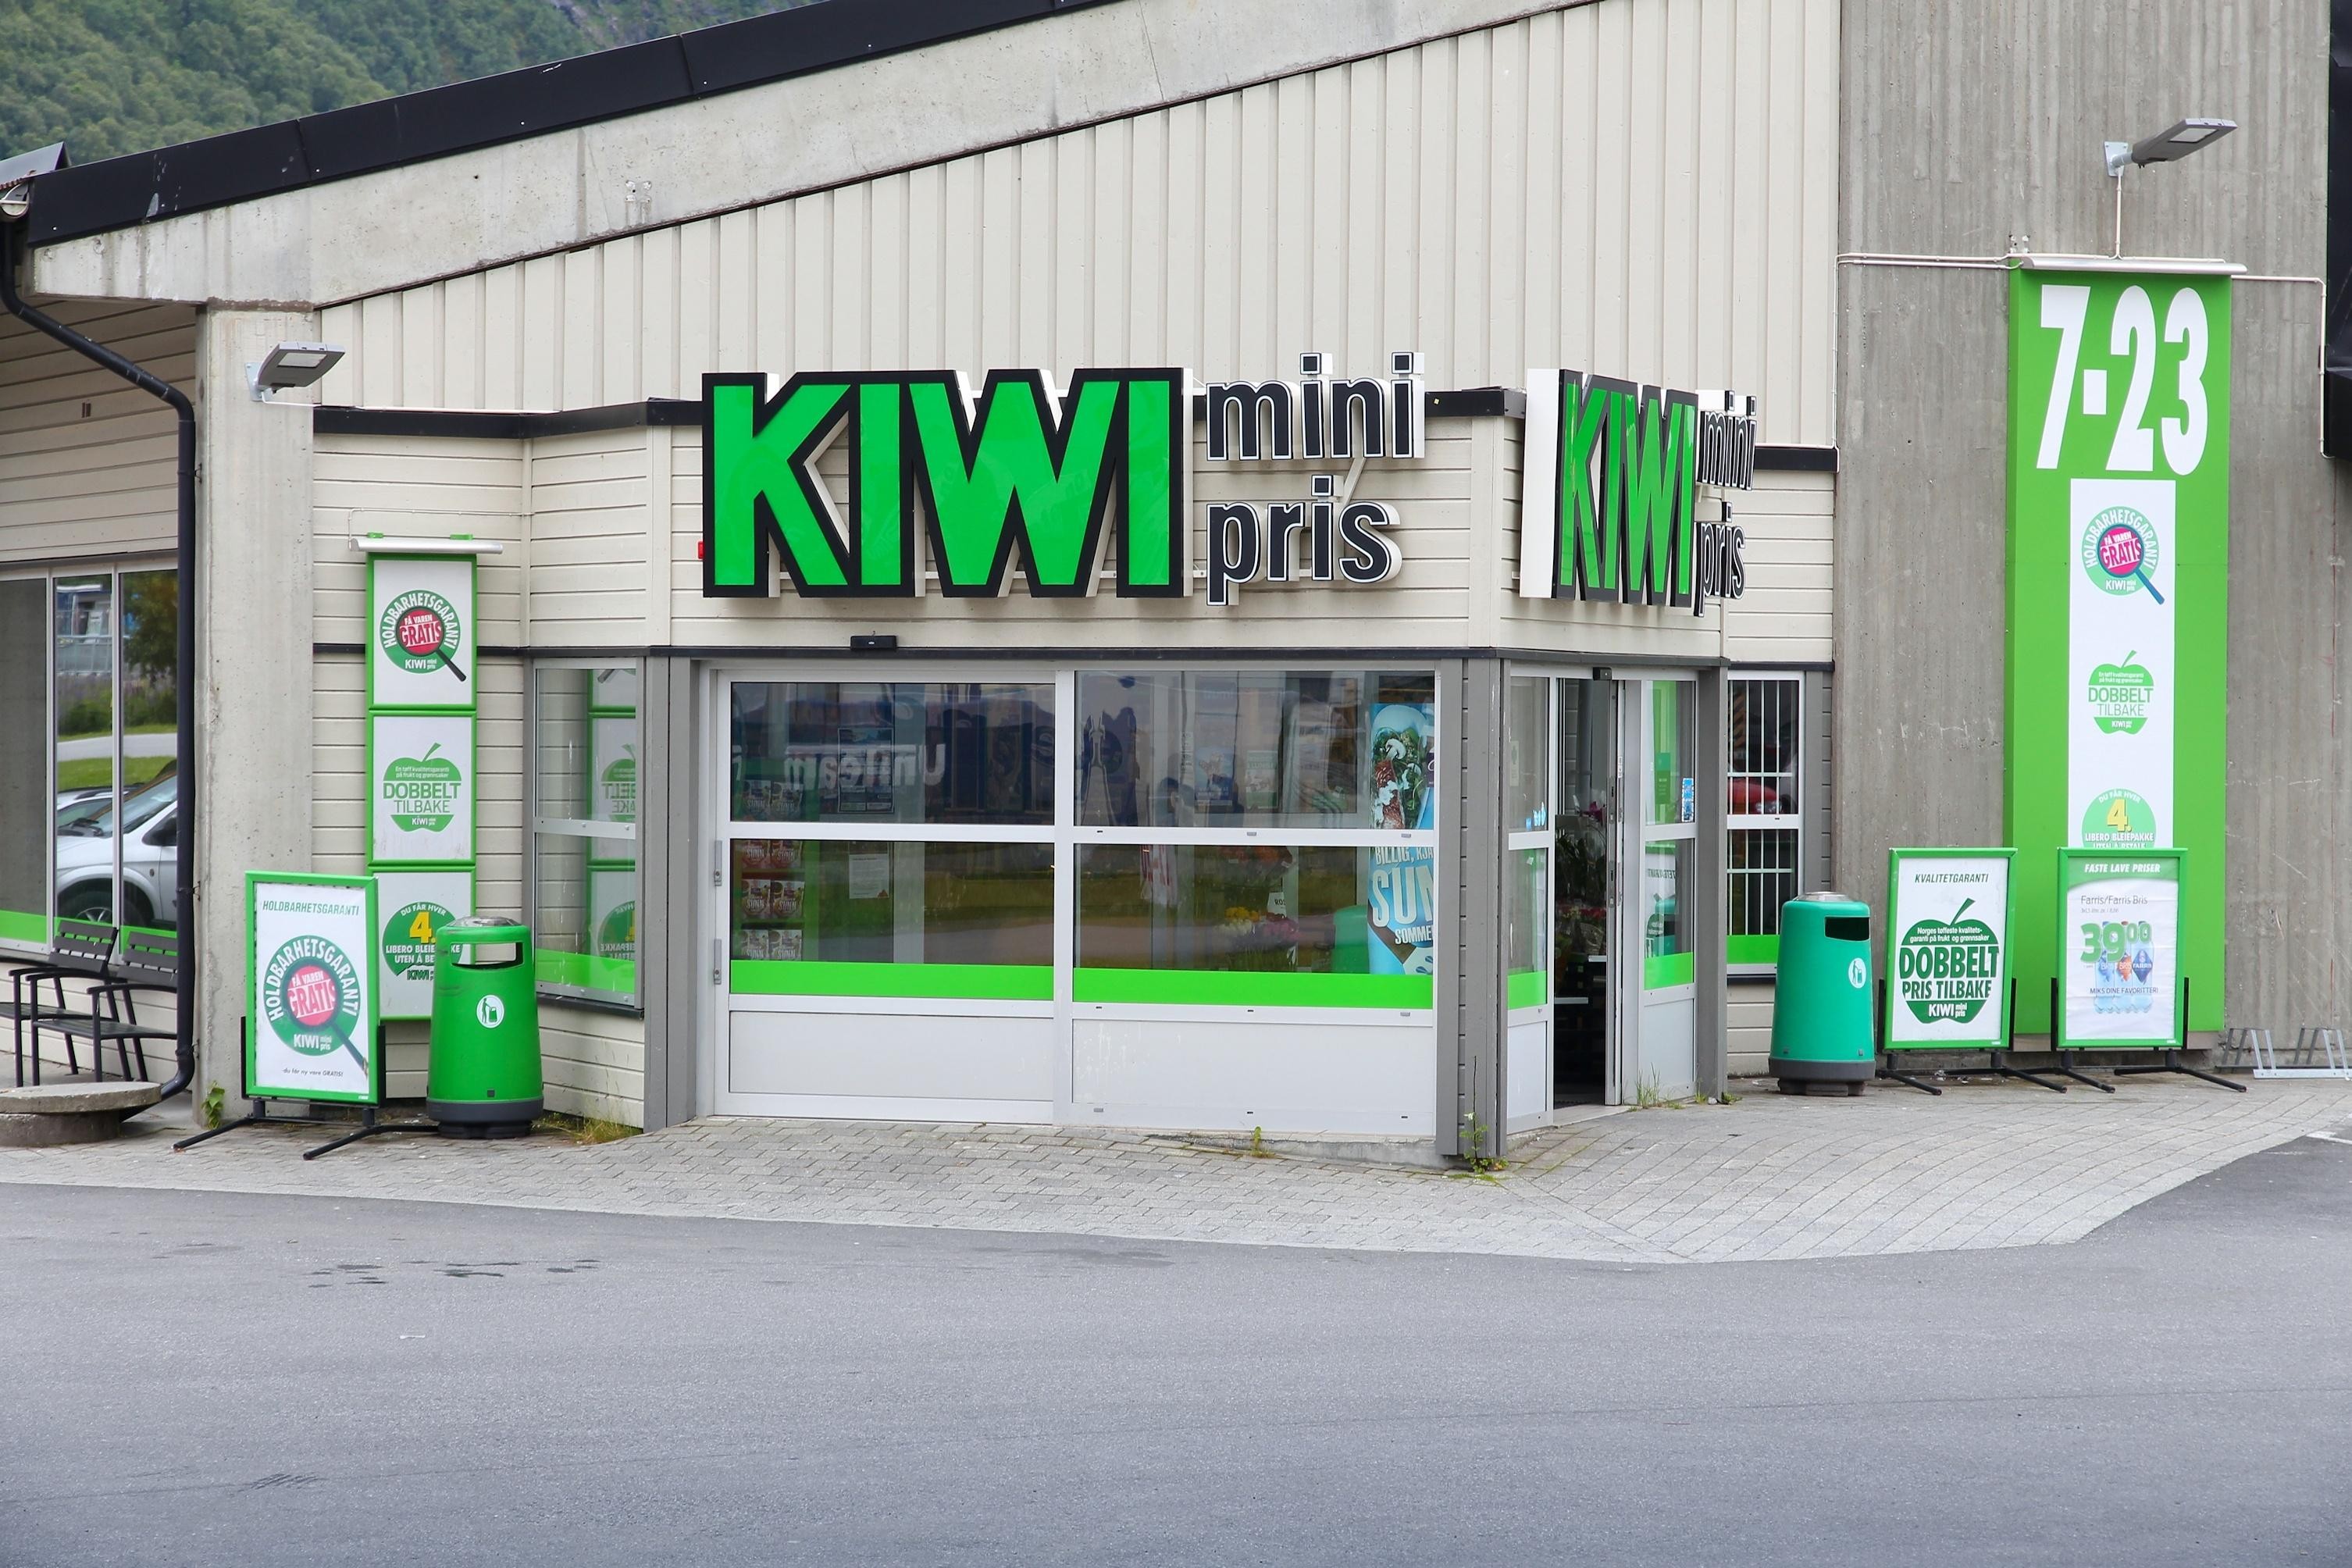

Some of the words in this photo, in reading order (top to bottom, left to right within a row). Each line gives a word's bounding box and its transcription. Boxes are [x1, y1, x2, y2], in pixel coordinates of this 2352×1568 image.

[2036, 284, 2209, 476] 7-23
[1206, 352, 1424, 461] mini
[1698, 390, 1757, 490] mini
[702, 367, 1188, 598] KIWI
[1552, 369, 1699, 608] KIWI
[1206, 475, 1401, 607] pris
[2083, 509, 2158, 569] HOLDBARHETSGARANTI
[2112, 531, 2133, 543] VAREN
[1693, 501, 1746, 618] pris
[2101, 539, 2141, 568] GRATIS
[2105, 579, 2126, 590] KIWI
[382, 593, 458, 649] HOLDBARHETSGARANTI
[404, 615, 413, 625] FÅ
[413, 614, 433, 625] VAREN
[400, 622, 441, 647] GRATIS
[404, 659, 426, 669] KIWI
[2088, 687, 2154, 703] DOBBELT
[2097, 704, 2144, 716] TILBAKE
[383, 782, 461, 799] DOBBELT
[2098, 793, 2109, 803] DU
[2123, 791, 2141, 804] HVER
[394, 800, 451, 813] TILBAKE
[2086, 833, 2111, 842] LIBERO
[2112, 832, 2154, 842] BLEIEPAKKE
[2084, 864, 2108, 873] FASTE
[2111, 864, 2129, 873] LAVE
[2133, 864, 2161, 873] PRISER
[1915, 873, 1989, 883] KVALITETGARANTI
[2080, 895, 2131, 904] Farris/Farris
[2133, 895, 2148, 904] Bris
[262, 900, 359, 916] HOLDBARHETSGARANTI
[401, 908, 411, 917] DU
[412, 903, 426, 911] FÅR
[428, 904, 447, 917] HVER
[409, 911, 436, 944] 4.
[1395, 925, 1434, 945] SOMME
[1917, 927, 1937, 935] Norges
[386, 945, 412, 953] LIBERO
[416, 954, 422, 963] Å
[1899, 946, 1999, 979] DOBBELT
[265, 939, 359, 1021] HOLDBARHETSGARANTI
[291, 975, 301, 988] FÅ
[302, 971, 324, 985] VAREN
[407, 970, 429, 980] KIWI
[287, 979, 336, 1015] GRATIS
[1902, 981, 1933, 1000] PRIS
[1937, 980, 1992, 1000] TILBAKE
[1929, 1003, 1955, 1017] KIWI
[294, 1034, 319, 1049] KIWI
[320, 1035, 332, 1043] mini
[320, 1042, 331, 1051] pris
